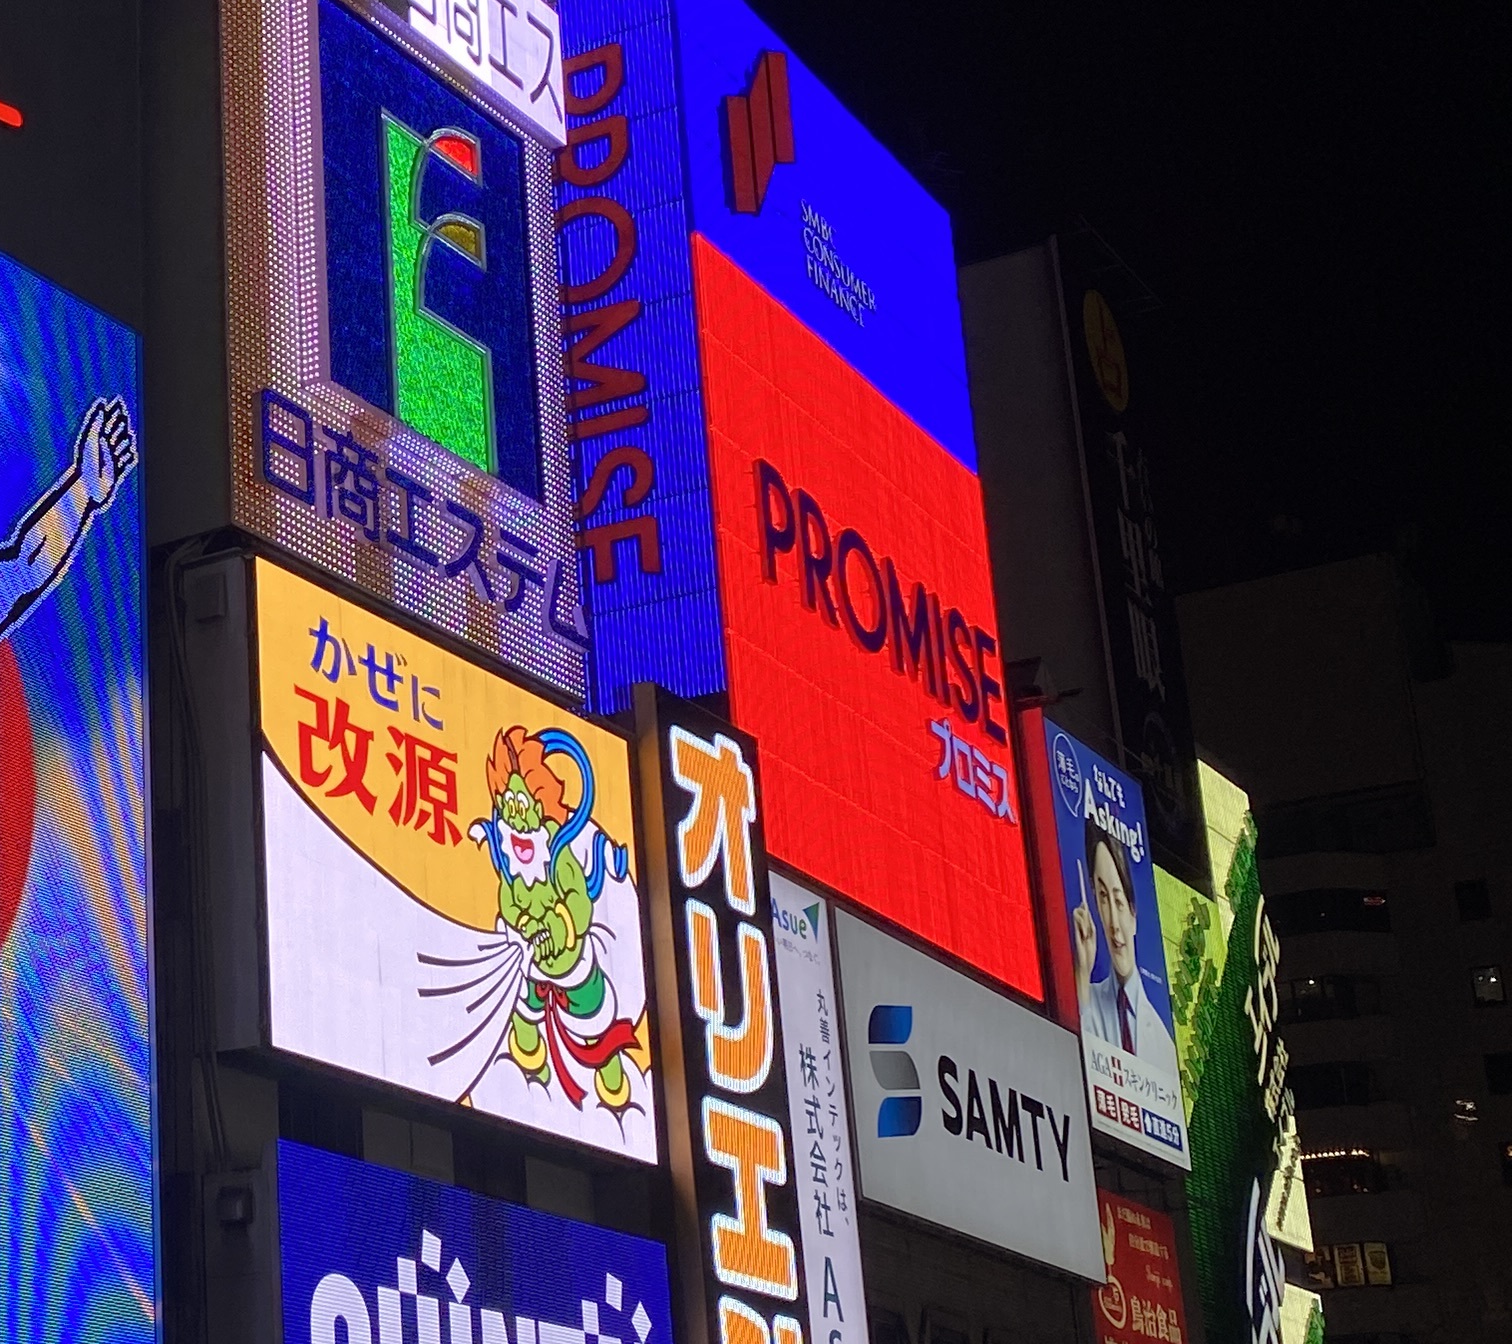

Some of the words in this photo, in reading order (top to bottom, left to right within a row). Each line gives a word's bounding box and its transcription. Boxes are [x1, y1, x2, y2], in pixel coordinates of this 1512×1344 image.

[801, 199, 836, 244] SMBC
[803, 227, 877, 311] CONSUMER
[806, 256, 865, 328] FINANCE
[752, 457, 1008, 747] PROMISE
[308, 616, 445, 731] かぜに
[293, 683, 464, 847] 改源
[929, 717, 1018, 825] プロミス
[1084, 777, 1145, 863] Asking!
[771, 897, 807, 940] Asue
[799, 1042, 835, 1238] 株式会社
[937, 1055, 1070, 1182] SAMTY
